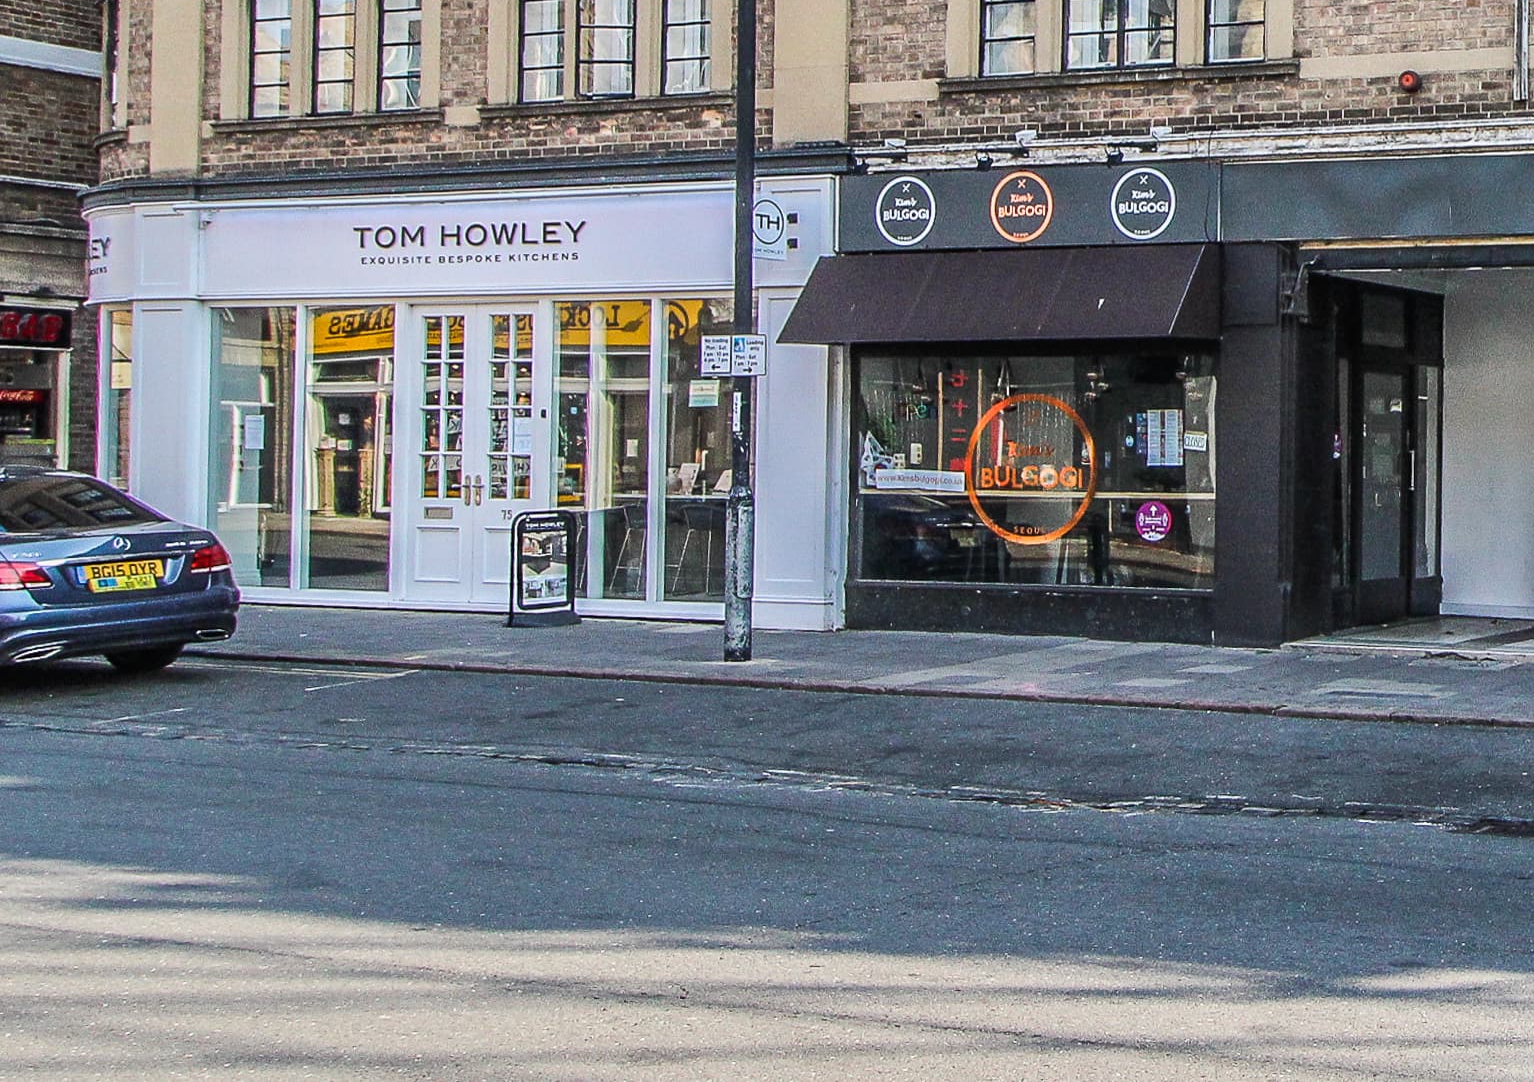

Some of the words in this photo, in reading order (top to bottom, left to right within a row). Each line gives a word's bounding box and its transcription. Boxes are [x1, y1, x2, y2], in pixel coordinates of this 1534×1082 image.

[998, 205, 1046, 218] BULGOGI
[1119, 201, 1169, 215] BULGOGI
[883, 209, 929, 221] BULGOGI
[755, 214, 780, 230] TH
[353, 226, 425, 248] TOM
[440, 220, 587, 247] HOWLEY
[361, 255, 432, 265] EXQUISITE
[438, 254, 502, 264] BESPOKE
[509, 252, 579, 262] KITCHENS
[981, 465, 1083, 489] BULGOGI
[501, 510, 513, 520] 75
